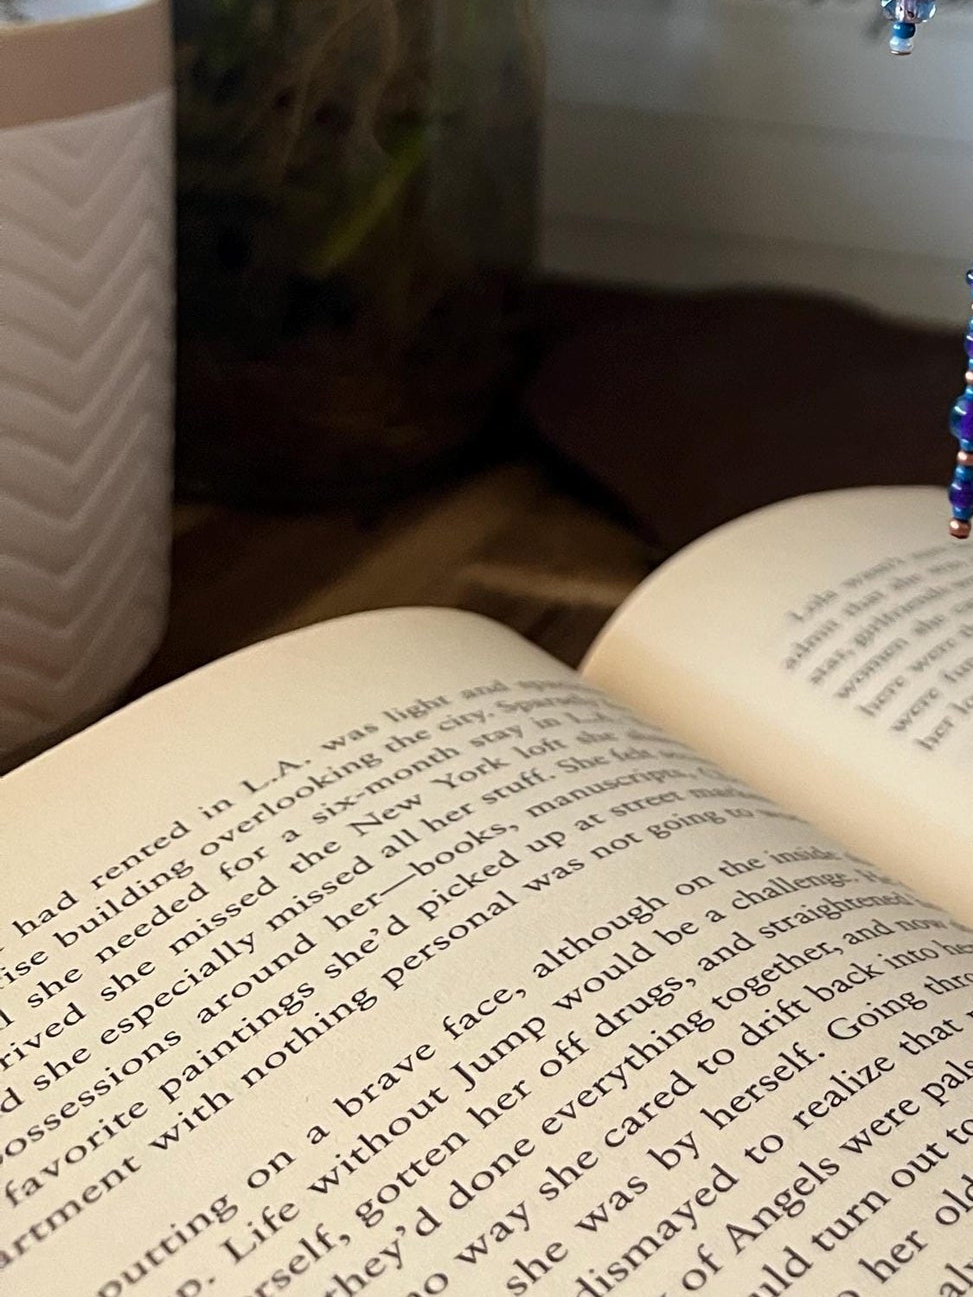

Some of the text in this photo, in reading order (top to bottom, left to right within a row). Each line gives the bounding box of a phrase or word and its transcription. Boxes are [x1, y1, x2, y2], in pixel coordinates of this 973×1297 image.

[11, 725, 379, 939] had rented was
[27, 747, 461, 1009] she needed for six-month
[32, 767, 556, 1092] she especially missed all her stuff.
[51, 730, 430, 949] building overlooking the
[100, 756, 510, 1002] she missed the New York
[4, 831, 566, 1208] favorite paintings she’d picked up
[147, 1092, 235, 1151] with
[239, 986, 378, 1089] nothing
[380, 889, 520, 992] personal
[521, 858, 586, 892] was
[589, 832, 644, 860] not
[646, 811, 727, 840] going
[196, 931, 318, 1025] around
[219, 921, 700, 1265] Life without Jump would be
[246, 858, 766, 1190] on a brave face, although on the
[354, 930, 757, 1229] gotten her off drugs, and
[448, 918, 896, 1210] done everything together, and
[453, 962, 886, 1265] way she cared to drift back
[506, 991, 928, 1297] she was by herself. Going
[574, 1162, 740, 1297] dismayed
[743, 1134, 784, 1165] to
[791, 1056, 896, 1131] realize
[898, 1019, 965, 1056] that
[681, 1242, 724, 1292] of
[725, 1157, 841, 1256] Angels
[838, 1099, 921, 1155] were
[810, 1190, 892, 1252] turn
[890, 1142, 950, 1189] out
[857, 1229, 929, 1285] her
